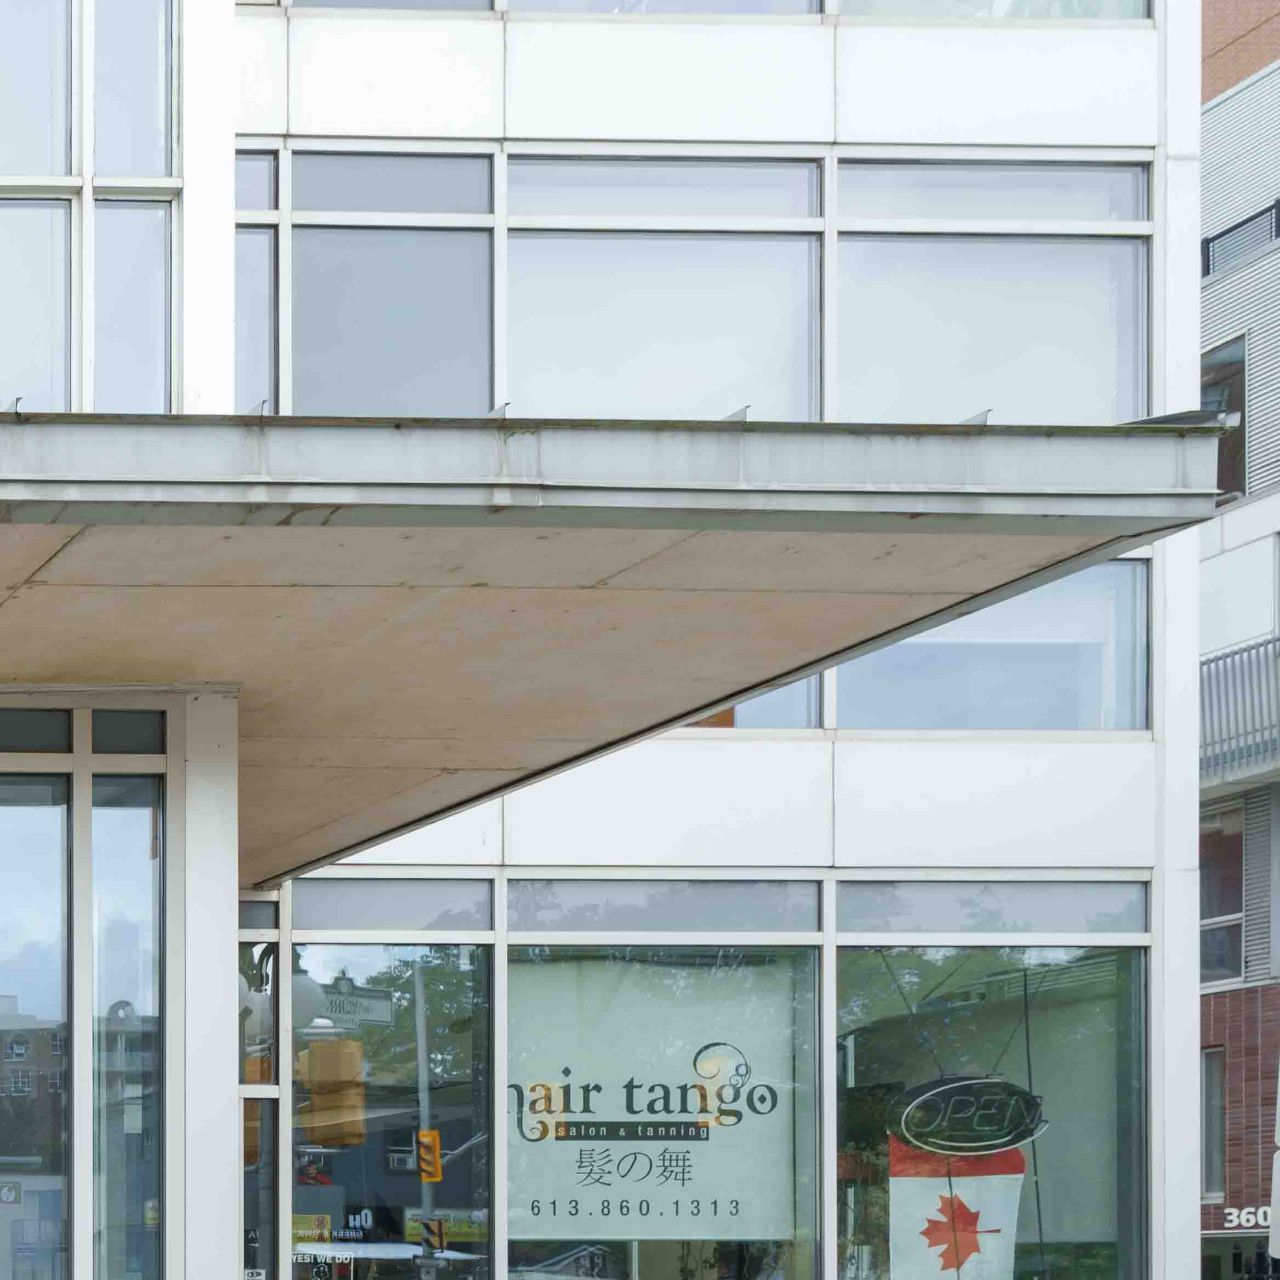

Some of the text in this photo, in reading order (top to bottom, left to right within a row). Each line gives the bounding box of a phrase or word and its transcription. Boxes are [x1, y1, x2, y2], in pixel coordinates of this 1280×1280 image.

[622, 1042, 778, 1126] tango
[909, 1095, 1041, 1132] OPEN
[557, 1125, 708, 1139] salon & tanning
[530, 1199, 740, 1217] 613.860.1313
[1223, 1206, 1271, 1229] 360
[292, 1254, 351, 1264] YES! WE DO
